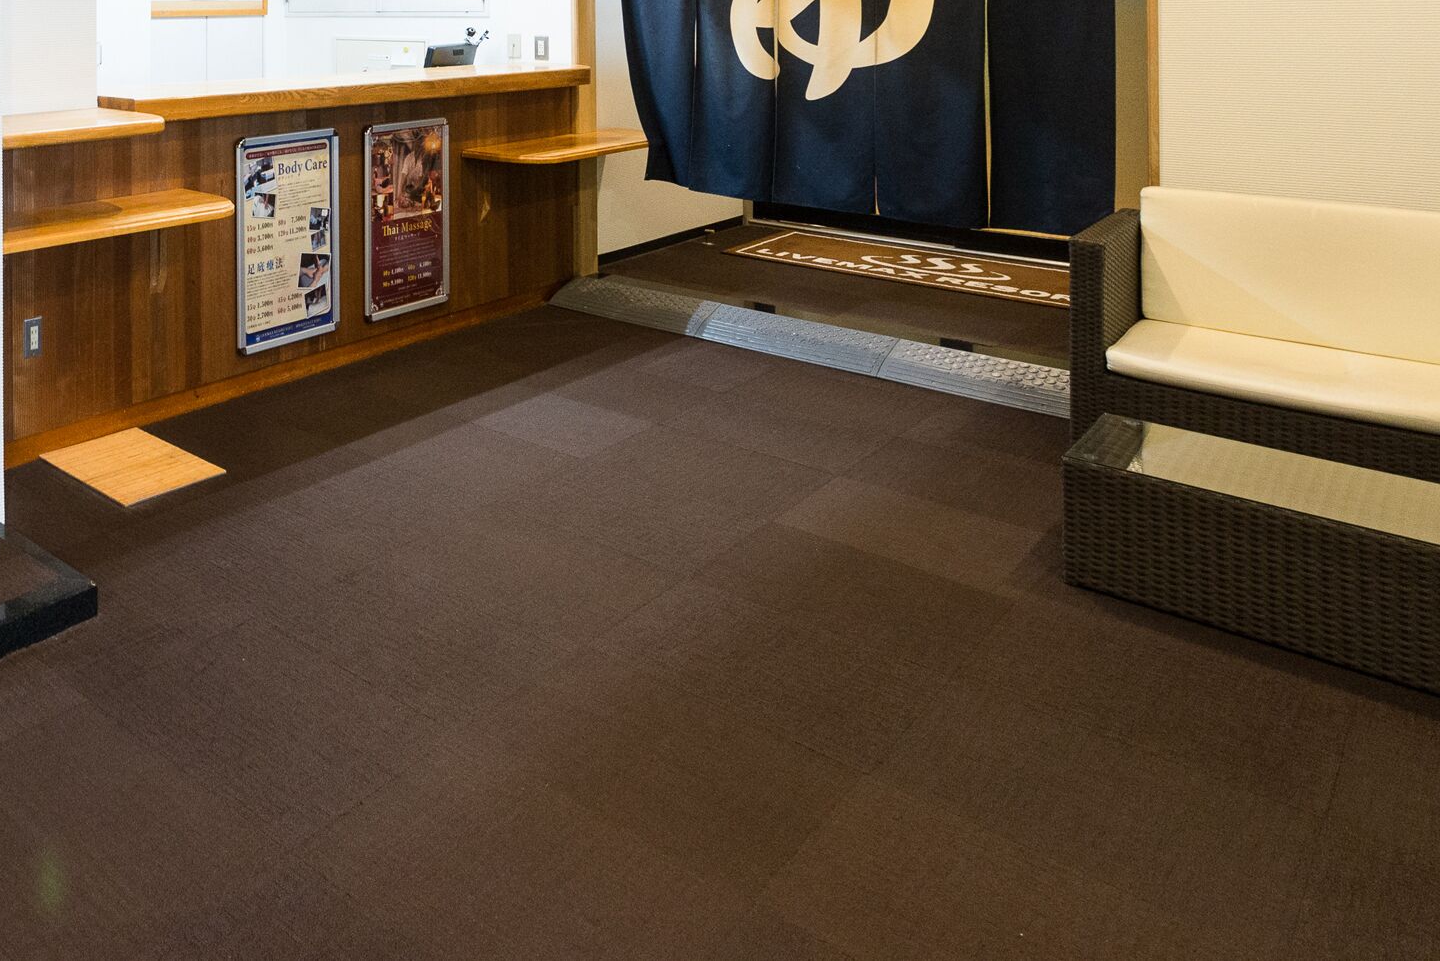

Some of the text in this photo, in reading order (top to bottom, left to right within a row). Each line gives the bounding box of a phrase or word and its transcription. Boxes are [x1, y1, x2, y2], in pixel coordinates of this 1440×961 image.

[278, 158, 328, 177] Body Care
[382, 218, 432, 237] Thai Massage
[247, 257, 283, 275] 足底療法
[935, 276, 1071, 302] RESOR
